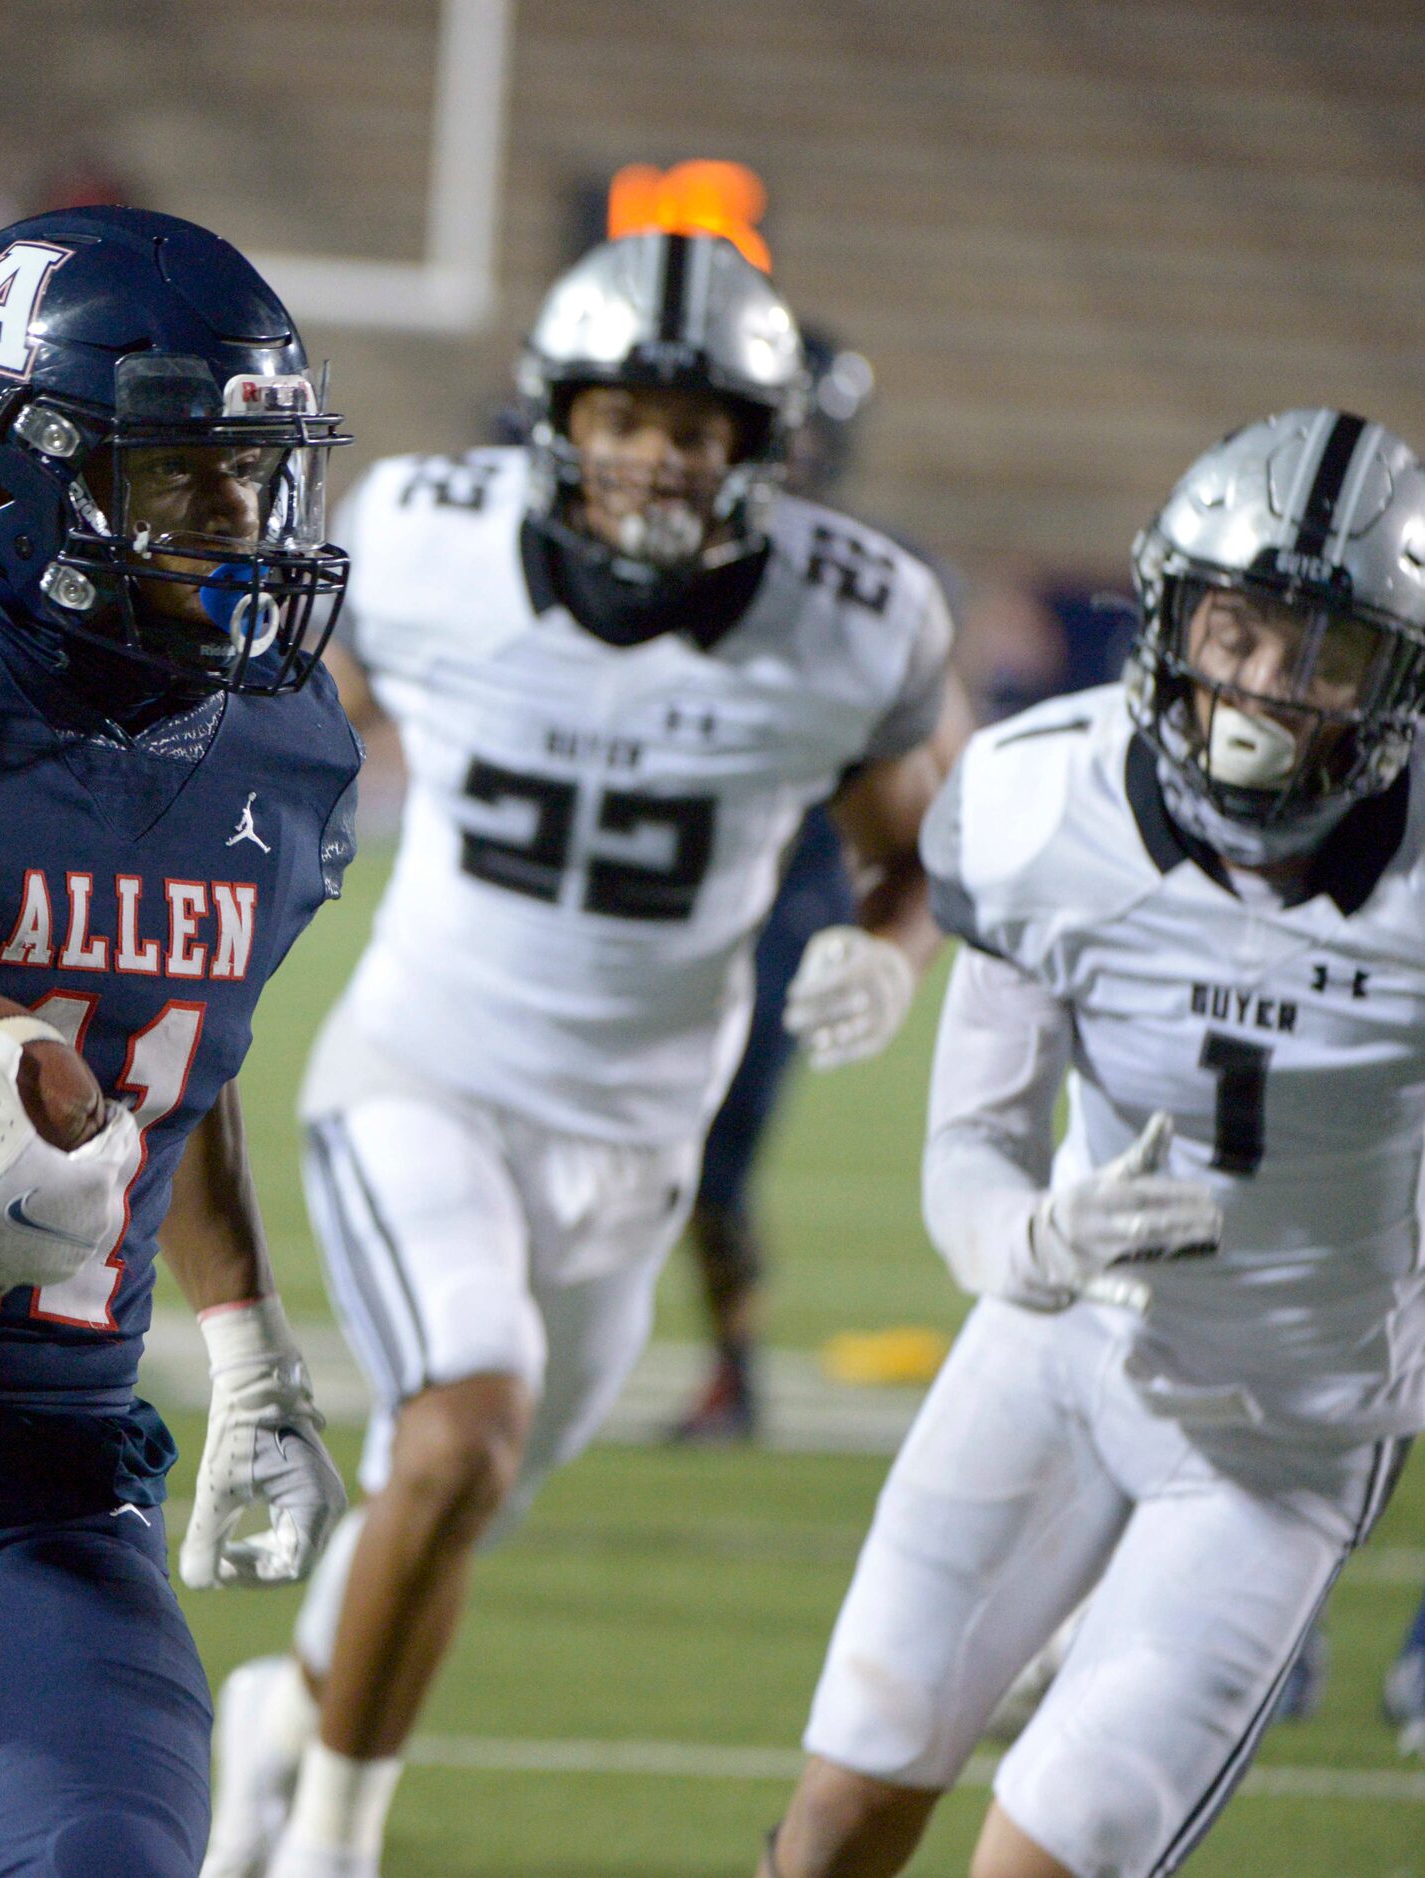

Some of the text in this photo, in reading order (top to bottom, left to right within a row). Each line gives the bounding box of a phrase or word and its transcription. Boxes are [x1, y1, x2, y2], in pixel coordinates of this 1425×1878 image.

[460, 750, 719, 923] 22
[1191, 976, 1298, 1035] GUYER
[1199, 1030, 1275, 1180] 1
